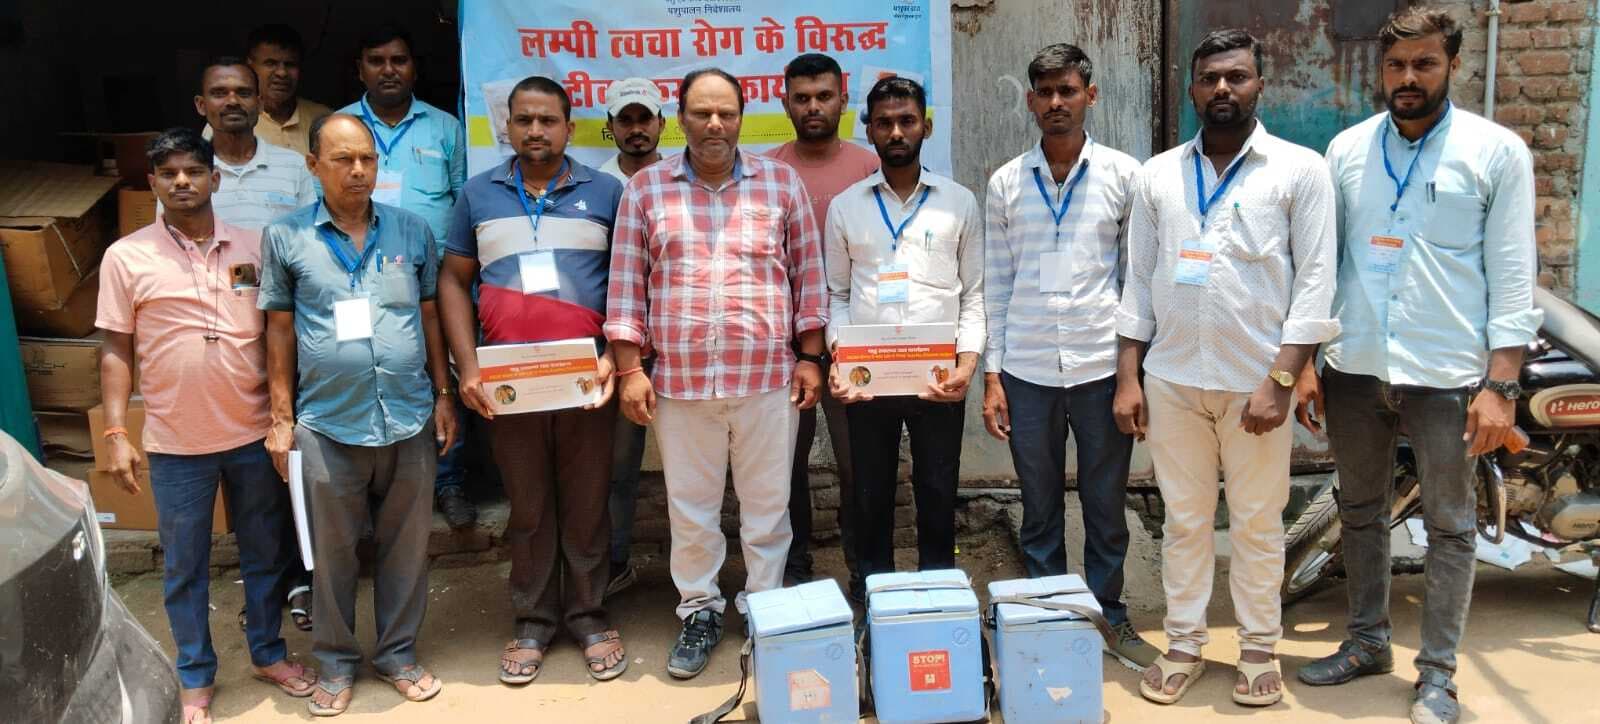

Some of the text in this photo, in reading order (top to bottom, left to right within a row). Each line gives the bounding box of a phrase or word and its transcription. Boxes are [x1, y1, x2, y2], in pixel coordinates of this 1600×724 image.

[518, 20, 598, 58] लम्पी
[608, 29, 681, 58] त्वचा
[691, 18, 744, 57] रोग
[753, 16, 785, 53] के
[1567, 400, 1600, 411] Hero
